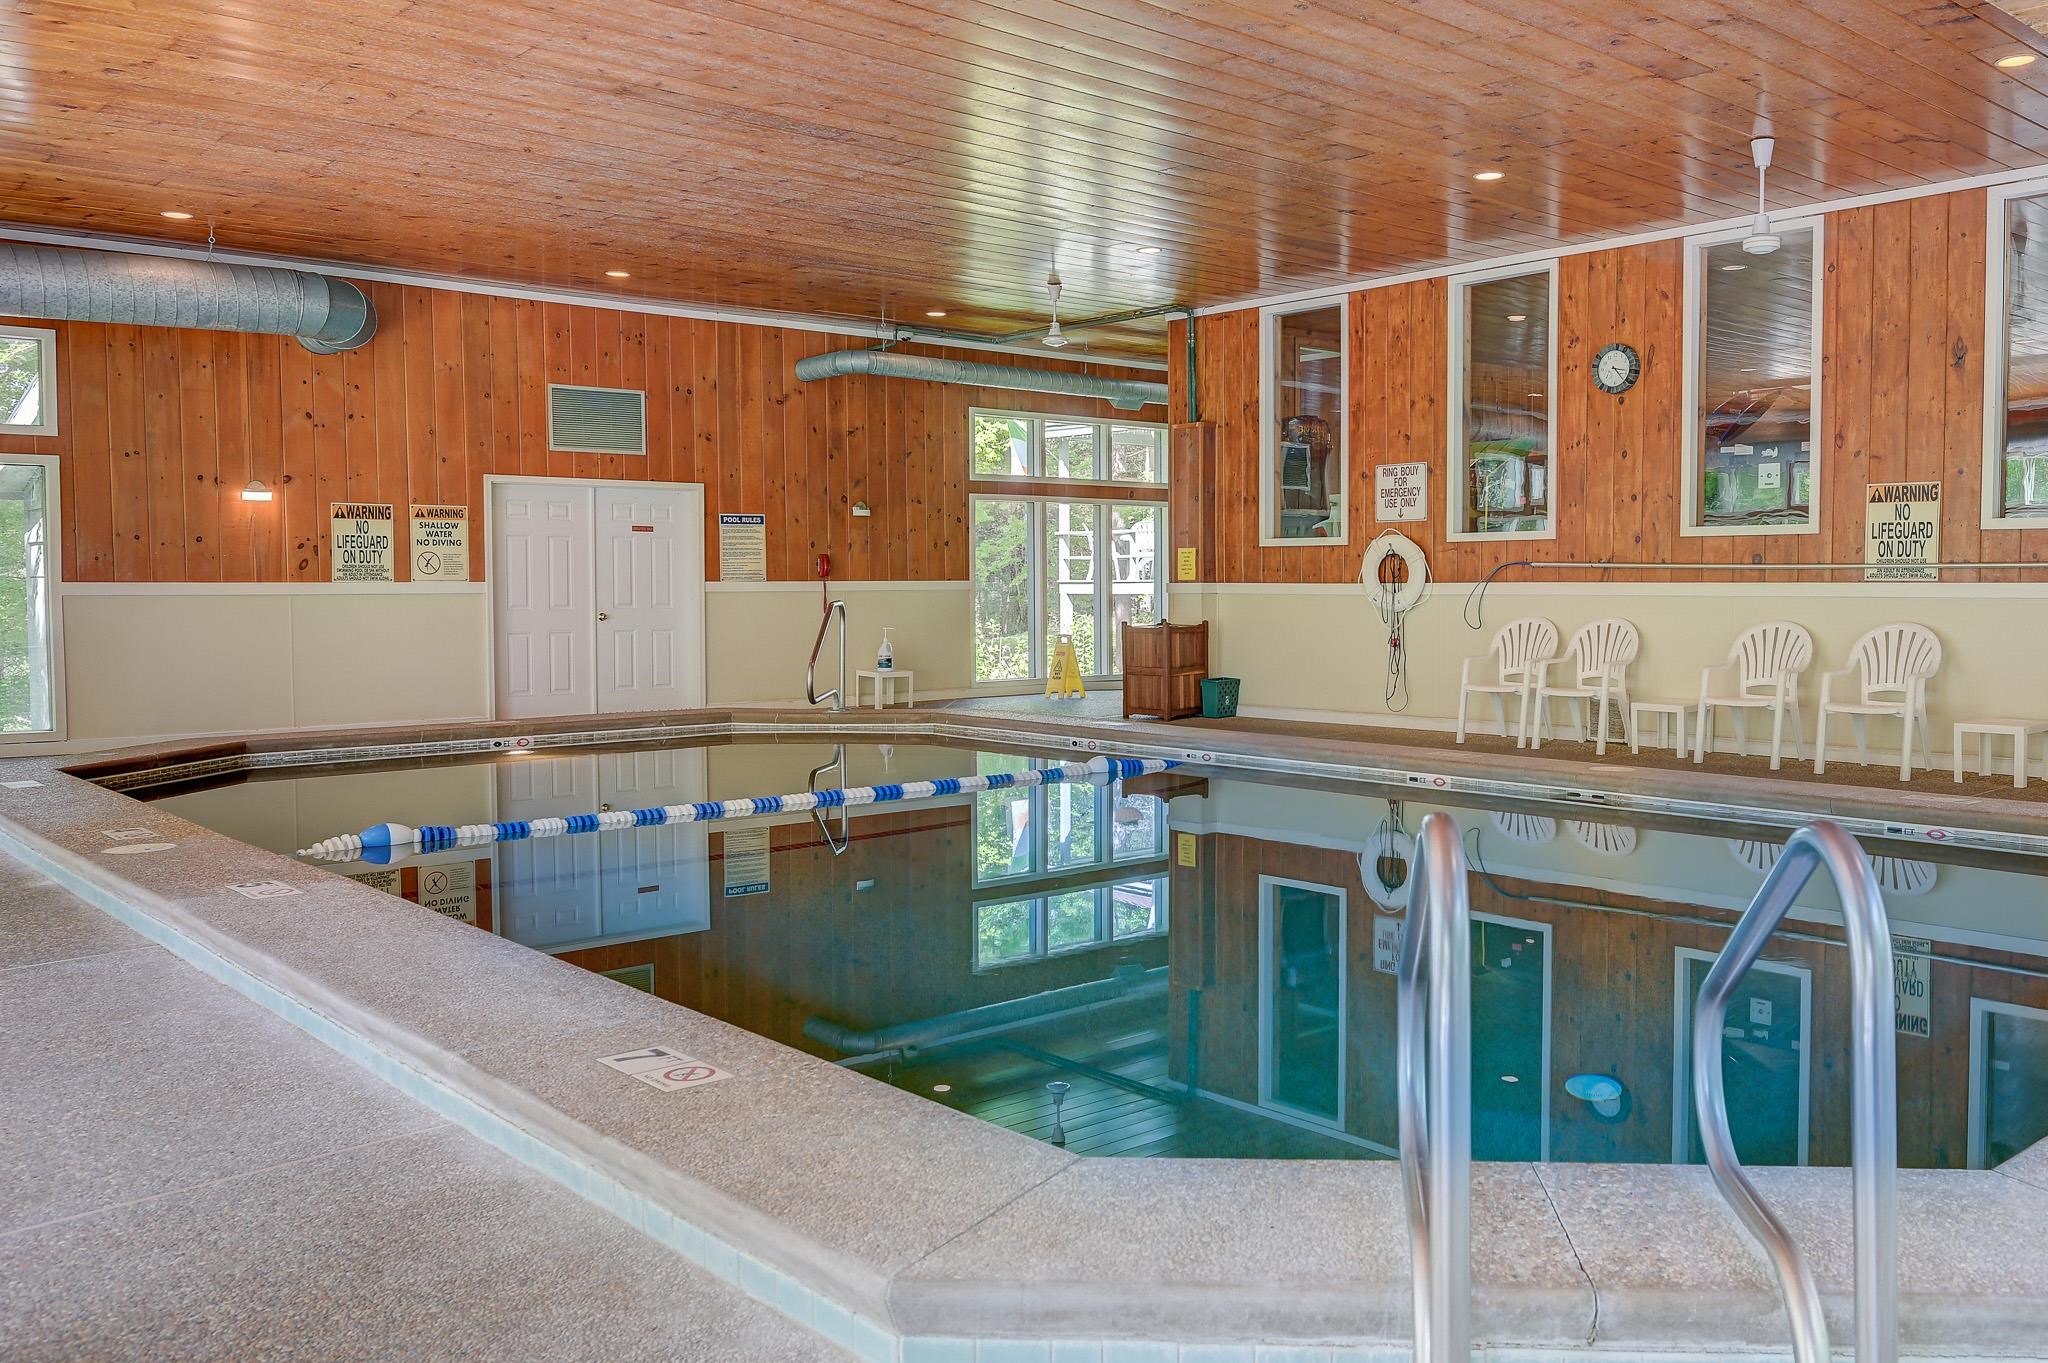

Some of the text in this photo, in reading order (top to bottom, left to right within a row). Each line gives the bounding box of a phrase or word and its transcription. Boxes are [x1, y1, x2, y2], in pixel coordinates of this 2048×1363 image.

[1382, 466, 1419, 477] RING BOUY
[1394, 477, 1407, 487] FOR
[1381, 487, 1421, 498] EMERGENCY
[1884, 485, 1938, 502] WARNING
[1385, 498, 1416, 508] USE ONLY
[346, 505, 391, 520] WARNING
[427, 508, 464, 518] WARNING
[1895, 504, 1910, 520] NO
[356, 520, 369, 534] NO
[1872, 522, 1933, 539] LIFEGUARD
[337, 535, 388, 549] LIFEGUARD
[1878, 540, 1926, 557] ON DUTY
[343, 550, 383, 563] ON DUTY
[613, 1048, 671, 1062] 7
